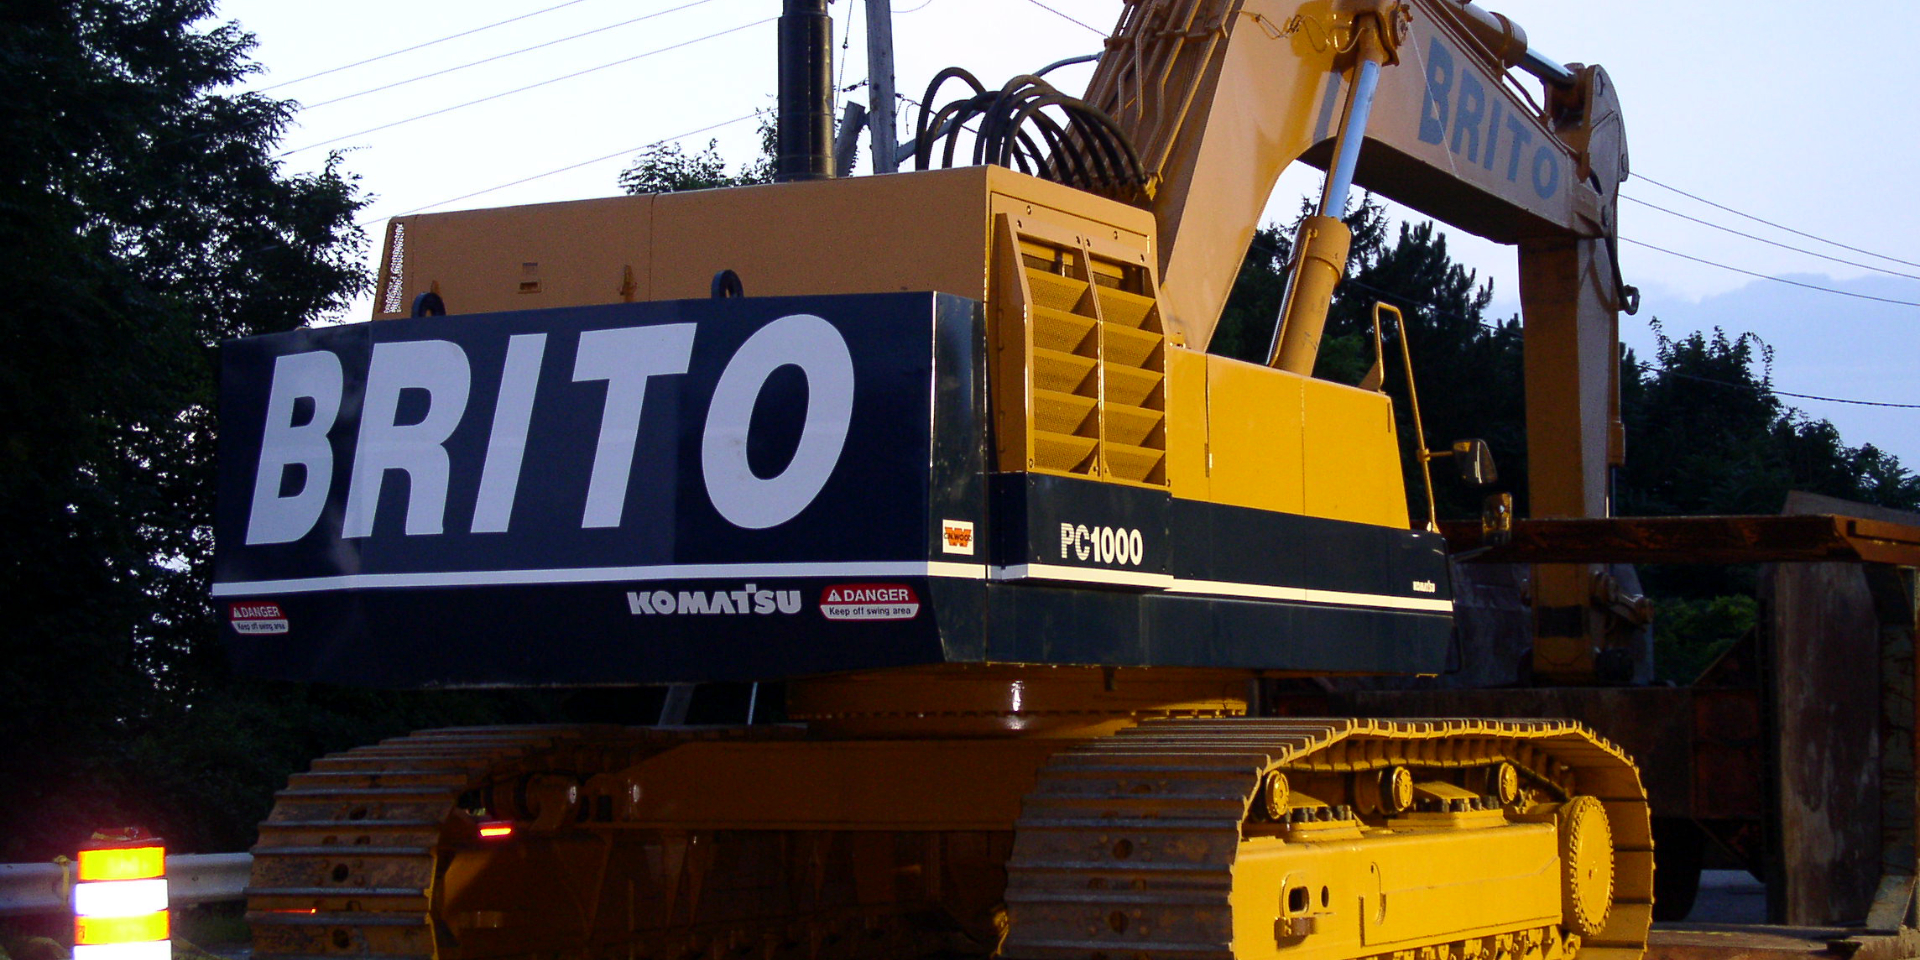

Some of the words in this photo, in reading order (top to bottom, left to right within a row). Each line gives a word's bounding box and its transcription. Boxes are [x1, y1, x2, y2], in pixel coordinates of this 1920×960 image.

[1418, 36, 1559, 200] BRITO
[246, 314, 855, 545] BRITO
[1060, 522, 1144, 566] PC1000
[627, 583, 802, 615] KOMATSU
[829, 607, 850, 616] Keep
[853, 607, 864, 615] off
[867, 607, 890, 616] swing
[843, 589, 909, 602] DANGER
[241, 606, 280, 618] DANGER
